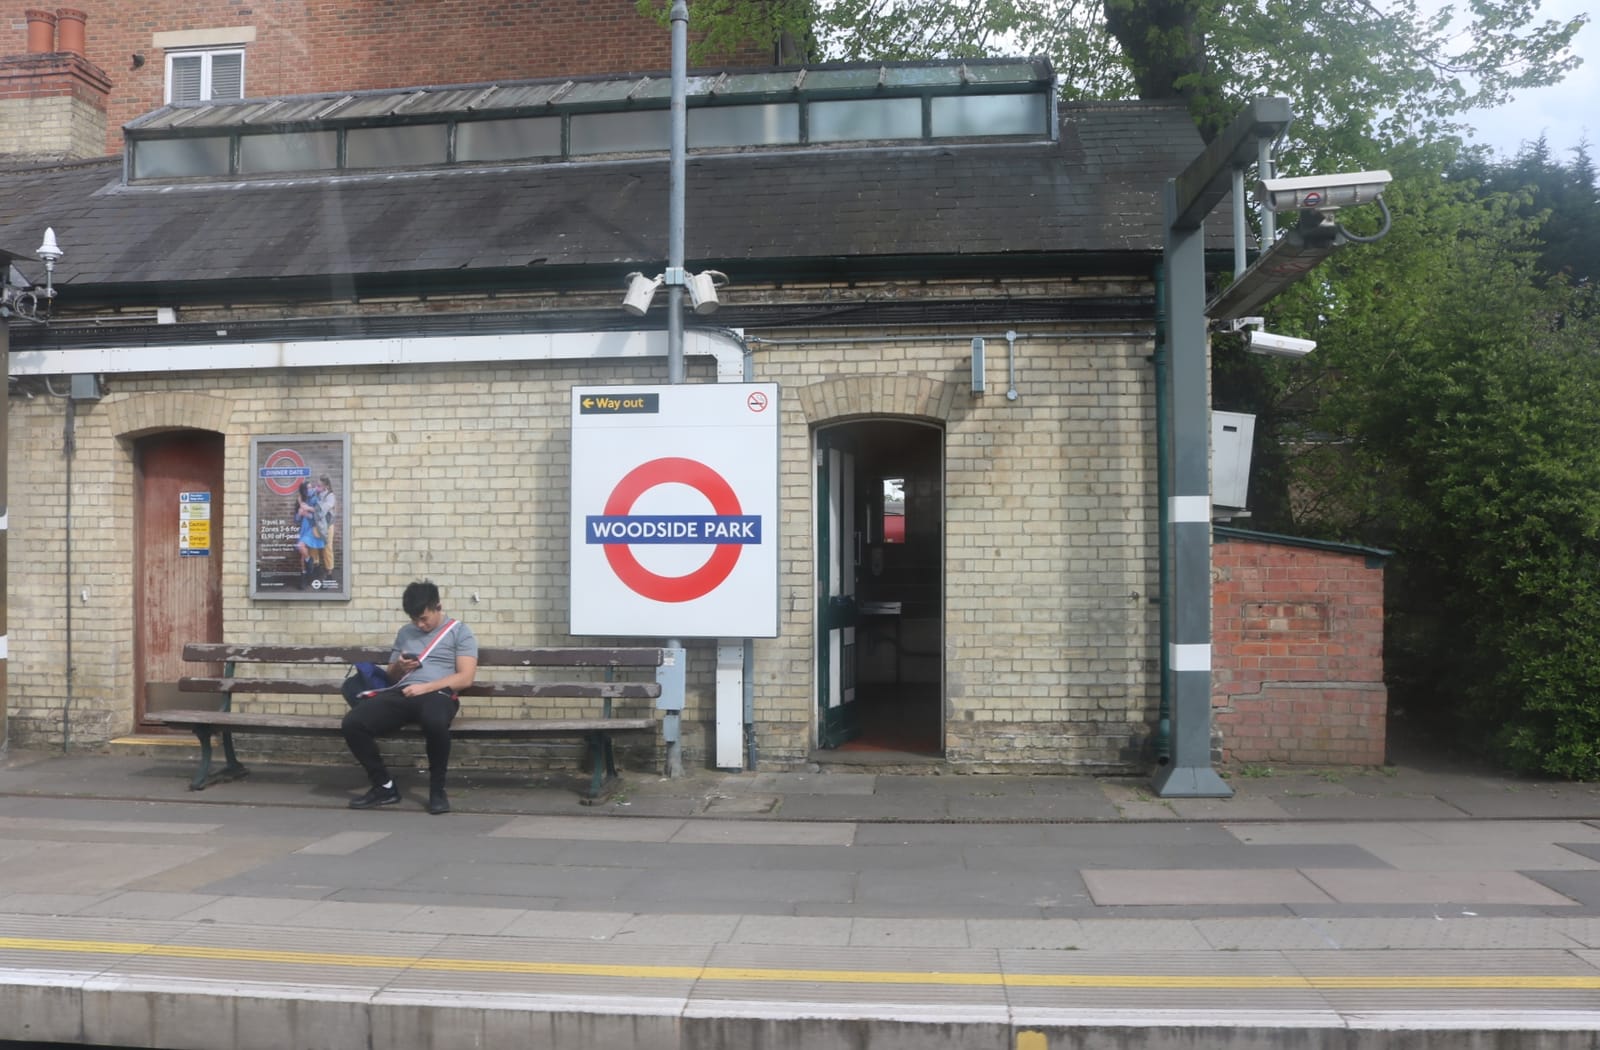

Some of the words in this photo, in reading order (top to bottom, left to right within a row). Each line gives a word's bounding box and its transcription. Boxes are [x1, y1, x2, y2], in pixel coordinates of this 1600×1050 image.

[596, 398, 620, 410] Way
[623, 399, 644, 408] out
[275, 532, 301, 540] off-peak
[592, 522, 698, 538] WOODSIDE
[704, 522, 755, 538] PARK
